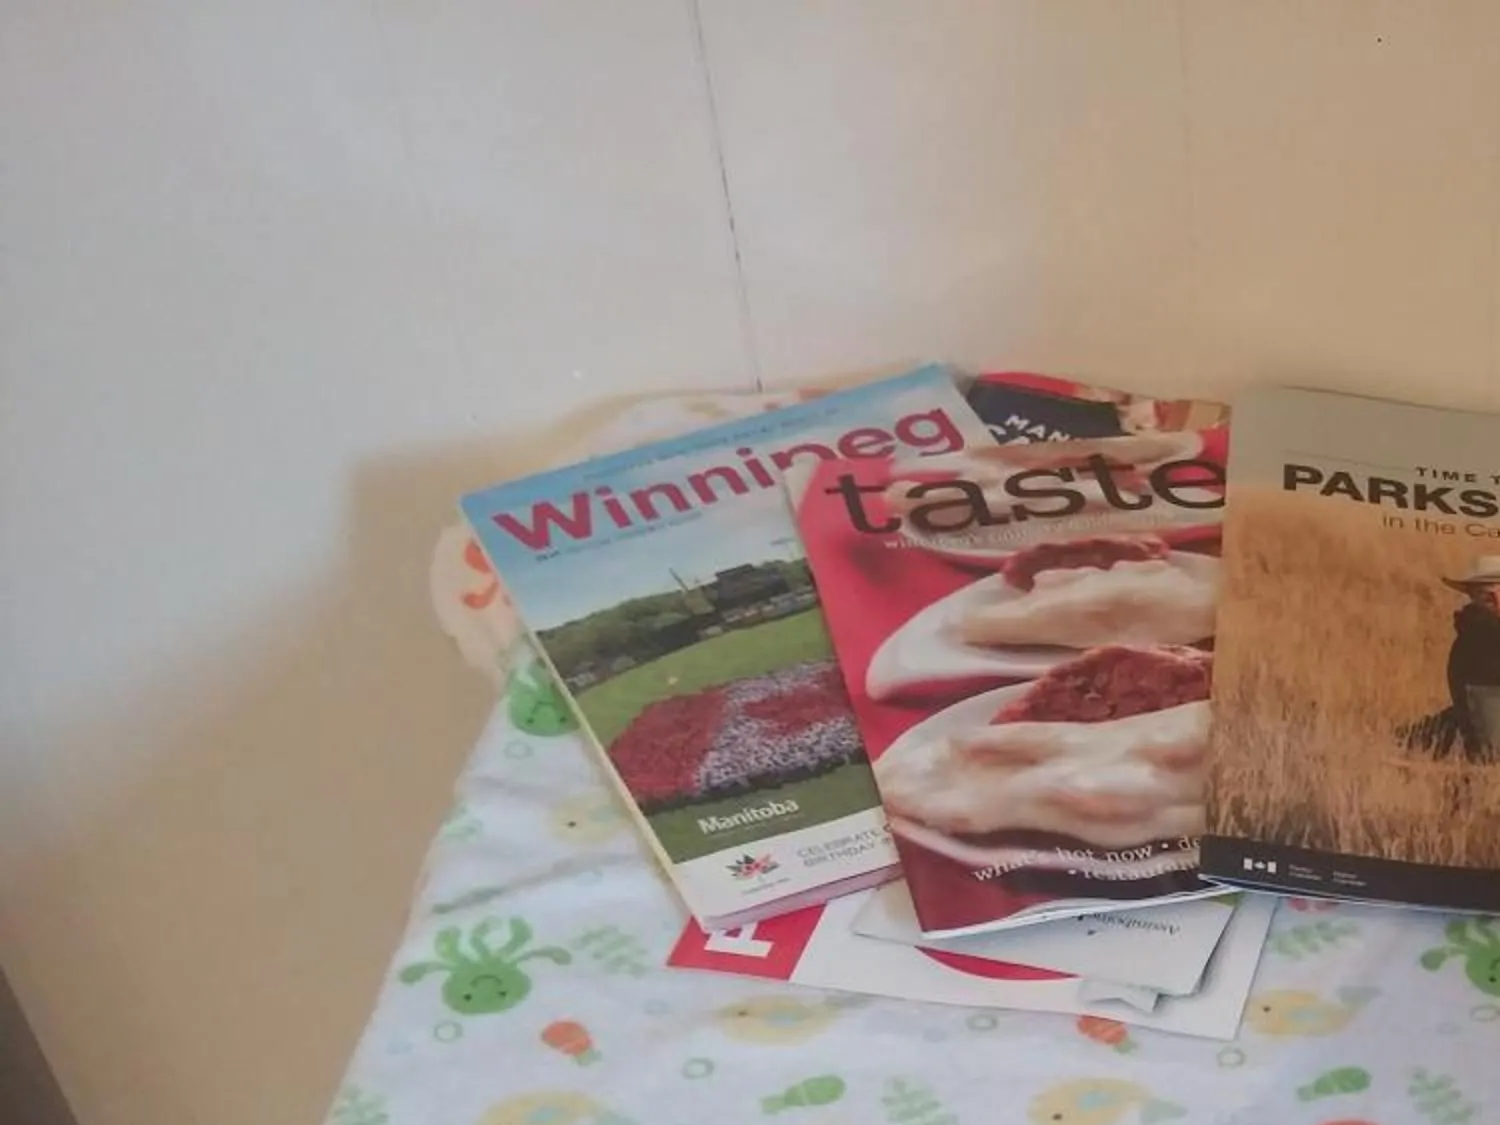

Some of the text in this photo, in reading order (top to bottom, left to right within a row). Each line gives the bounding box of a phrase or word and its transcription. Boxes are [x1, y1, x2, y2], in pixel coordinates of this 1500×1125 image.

[1415, 466, 1478, 483] TIME
[823, 453, 1226, 534] taste
[1283, 463, 1500, 519] PARKS
[1383, 513, 1404, 529] in
[1415, 517, 1456, 535] the
[696, 799, 800, 835] Manitoba
[1055, 846, 1095, 864] hot
[1105, 844, 1153, 864] now
